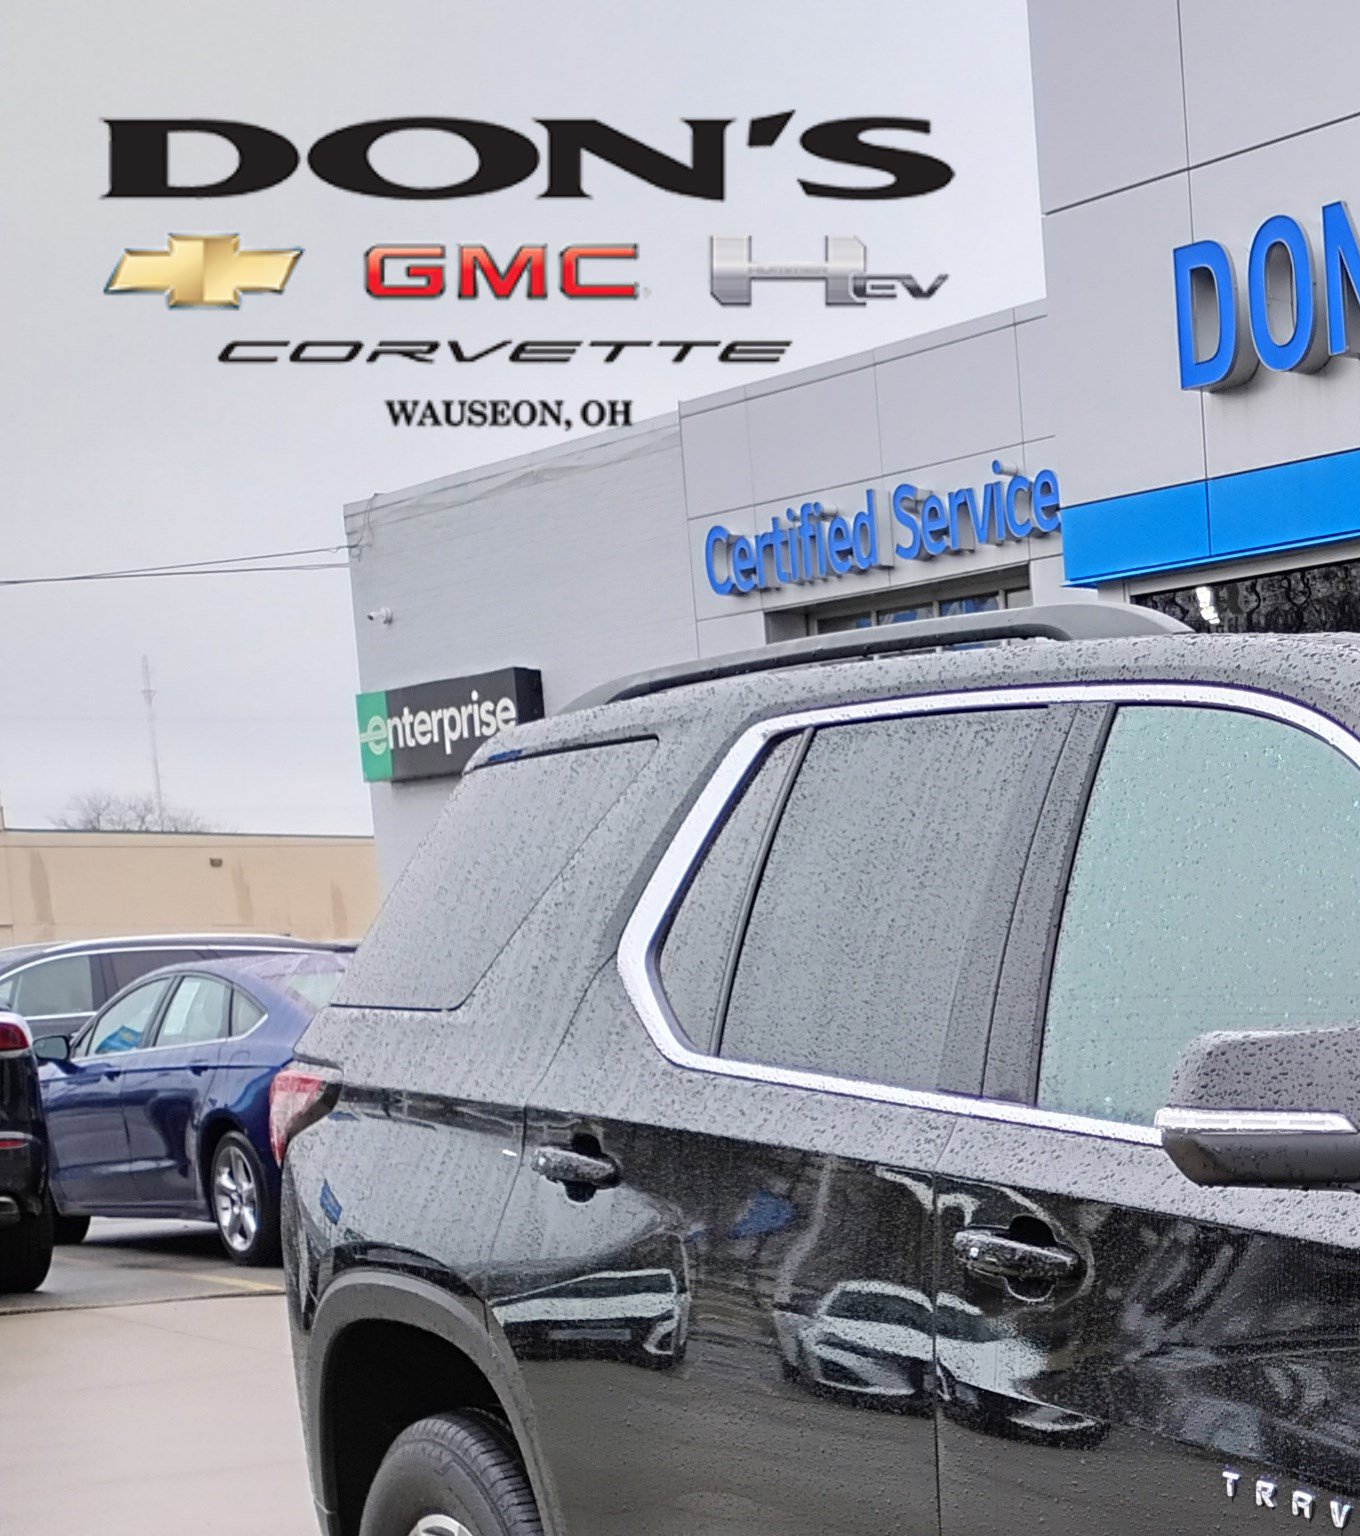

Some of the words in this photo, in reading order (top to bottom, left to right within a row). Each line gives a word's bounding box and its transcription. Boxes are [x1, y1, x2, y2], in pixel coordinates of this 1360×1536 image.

[705, 488, 878, 596] Certified
[892, 460, 1062, 560] Service
[361, 690, 516, 755] enterprise
